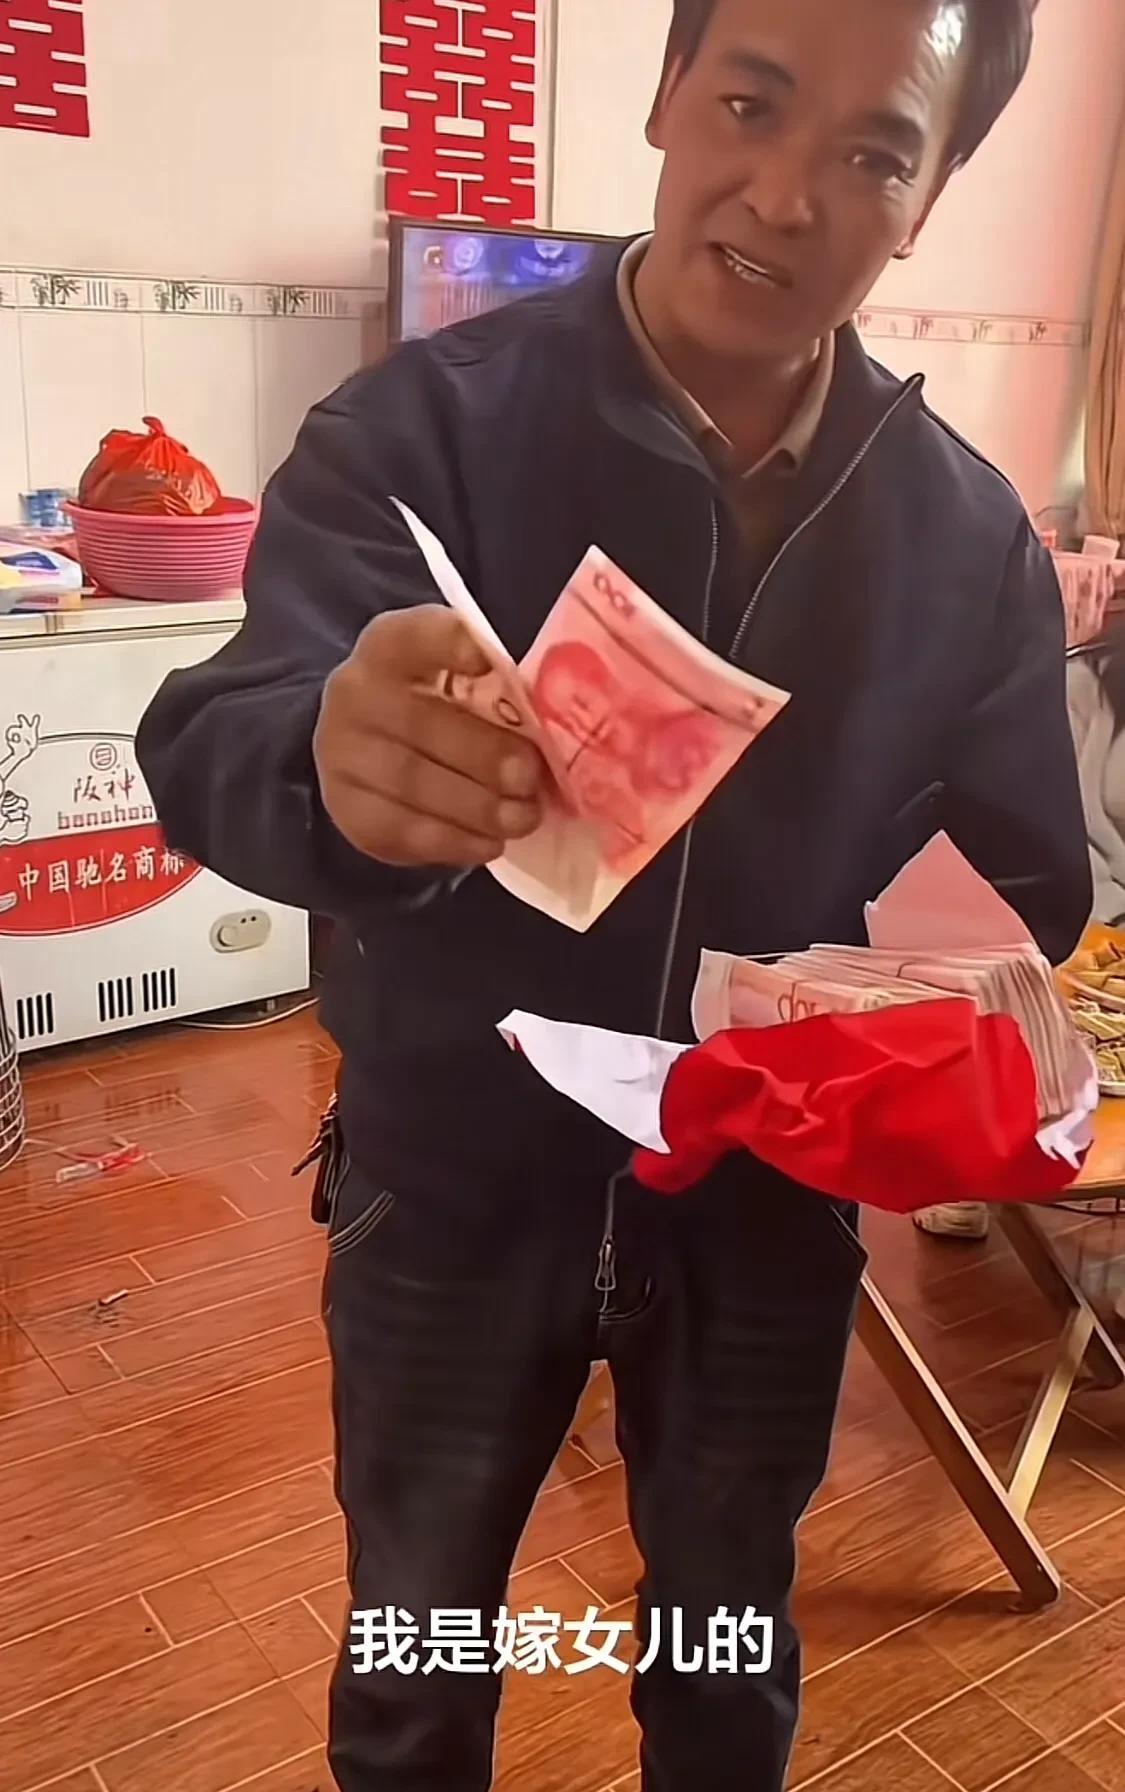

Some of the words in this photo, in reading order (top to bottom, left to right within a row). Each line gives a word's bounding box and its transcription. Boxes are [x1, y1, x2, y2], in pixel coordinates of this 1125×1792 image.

[18, 845, 185, 902] 中国驰名商标
